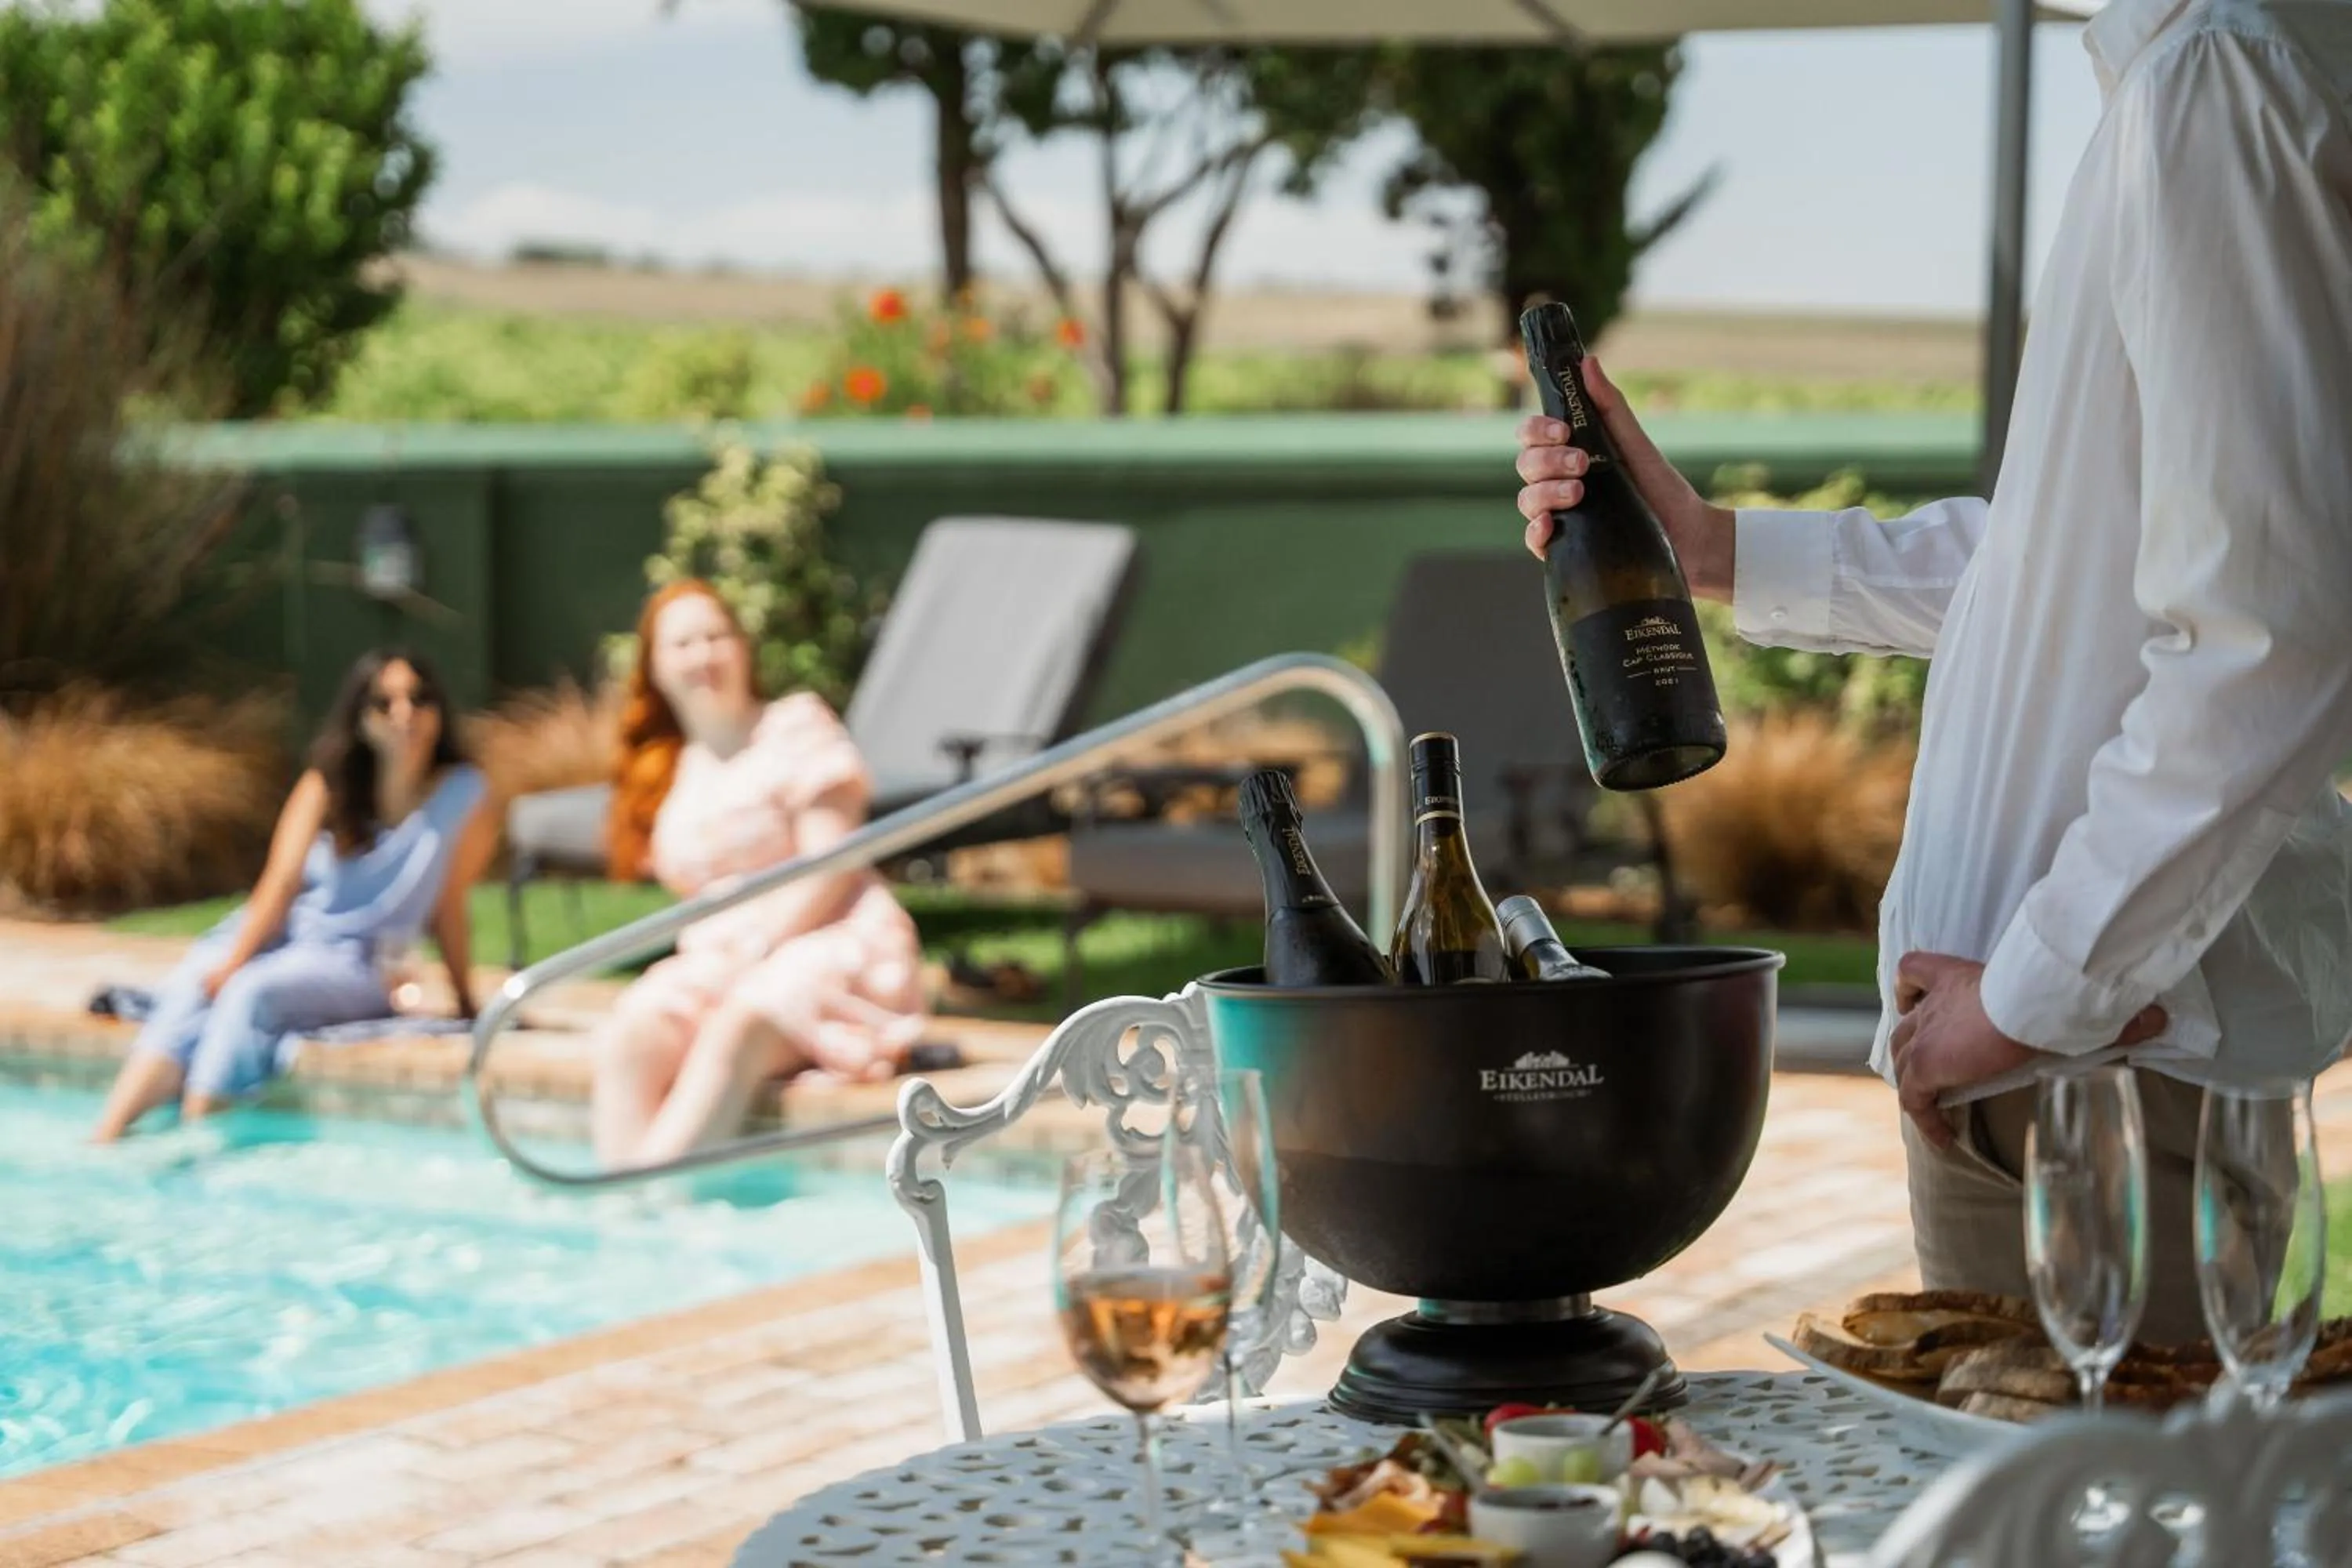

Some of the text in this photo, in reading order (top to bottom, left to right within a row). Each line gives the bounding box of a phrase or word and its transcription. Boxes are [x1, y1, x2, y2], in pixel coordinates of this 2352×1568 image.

[1557, 365, 1588, 429] EIKENDAL
[1624, 624, 1682, 641] EIKENDAL
[1479, 1063, 1605, 1091] EIKENDAL
